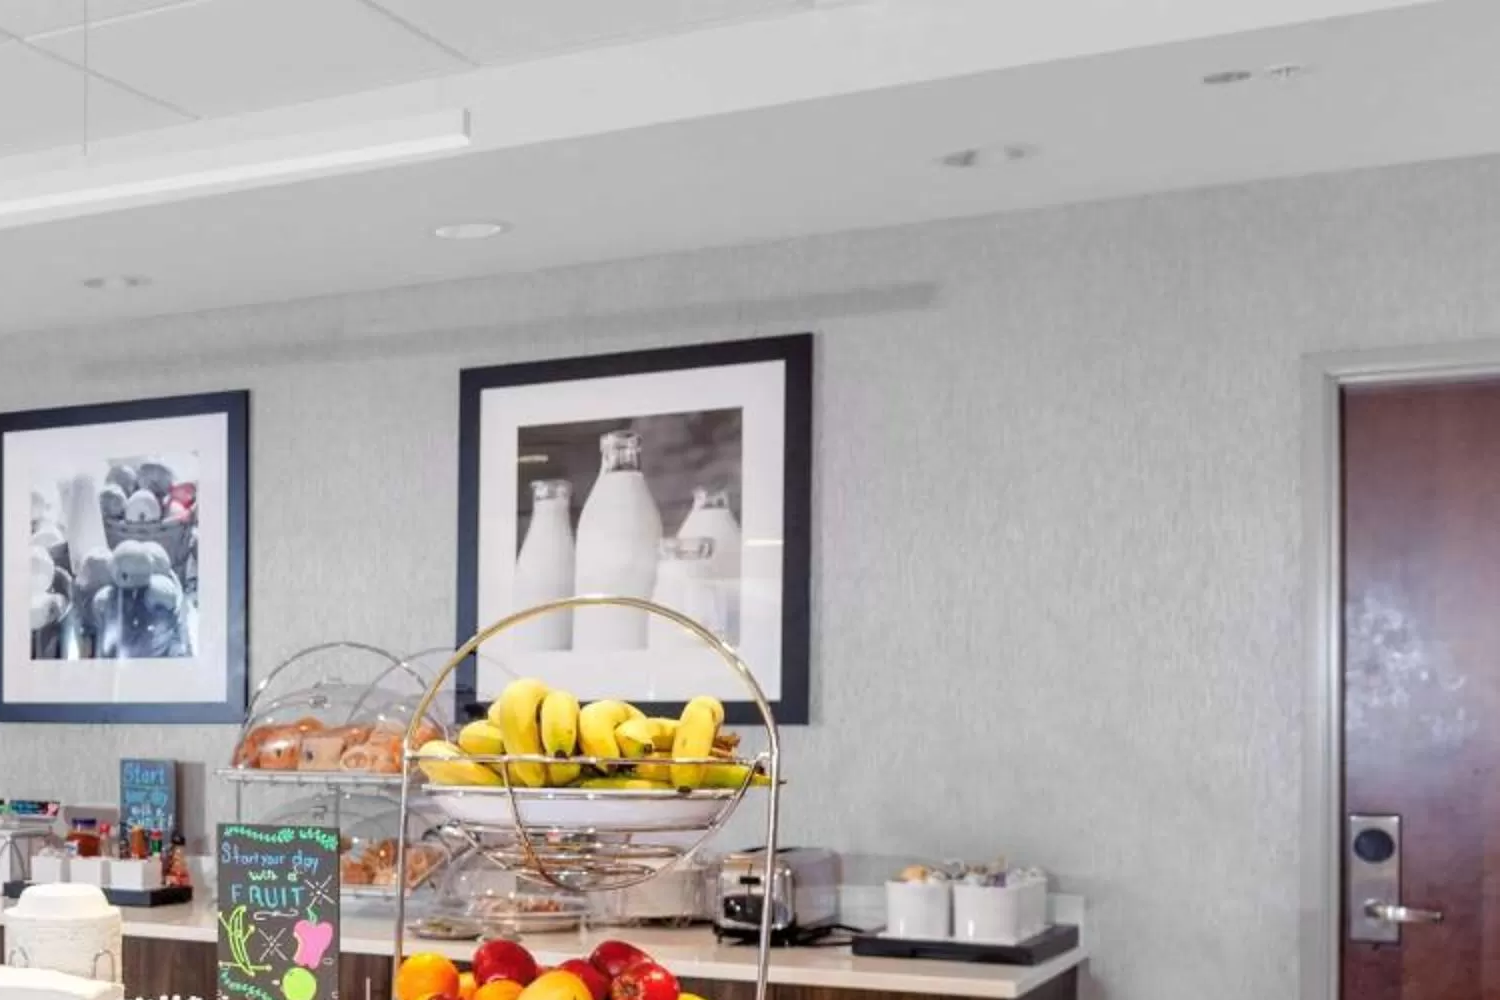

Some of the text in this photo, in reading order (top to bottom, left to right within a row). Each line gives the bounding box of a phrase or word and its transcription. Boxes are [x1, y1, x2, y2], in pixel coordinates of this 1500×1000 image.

[124, 763, 165, 785] Start
[221, 841, 260, 865] Start
[291, 849, 319, 876] day
[231, 883, 305, 908] FRUIT
